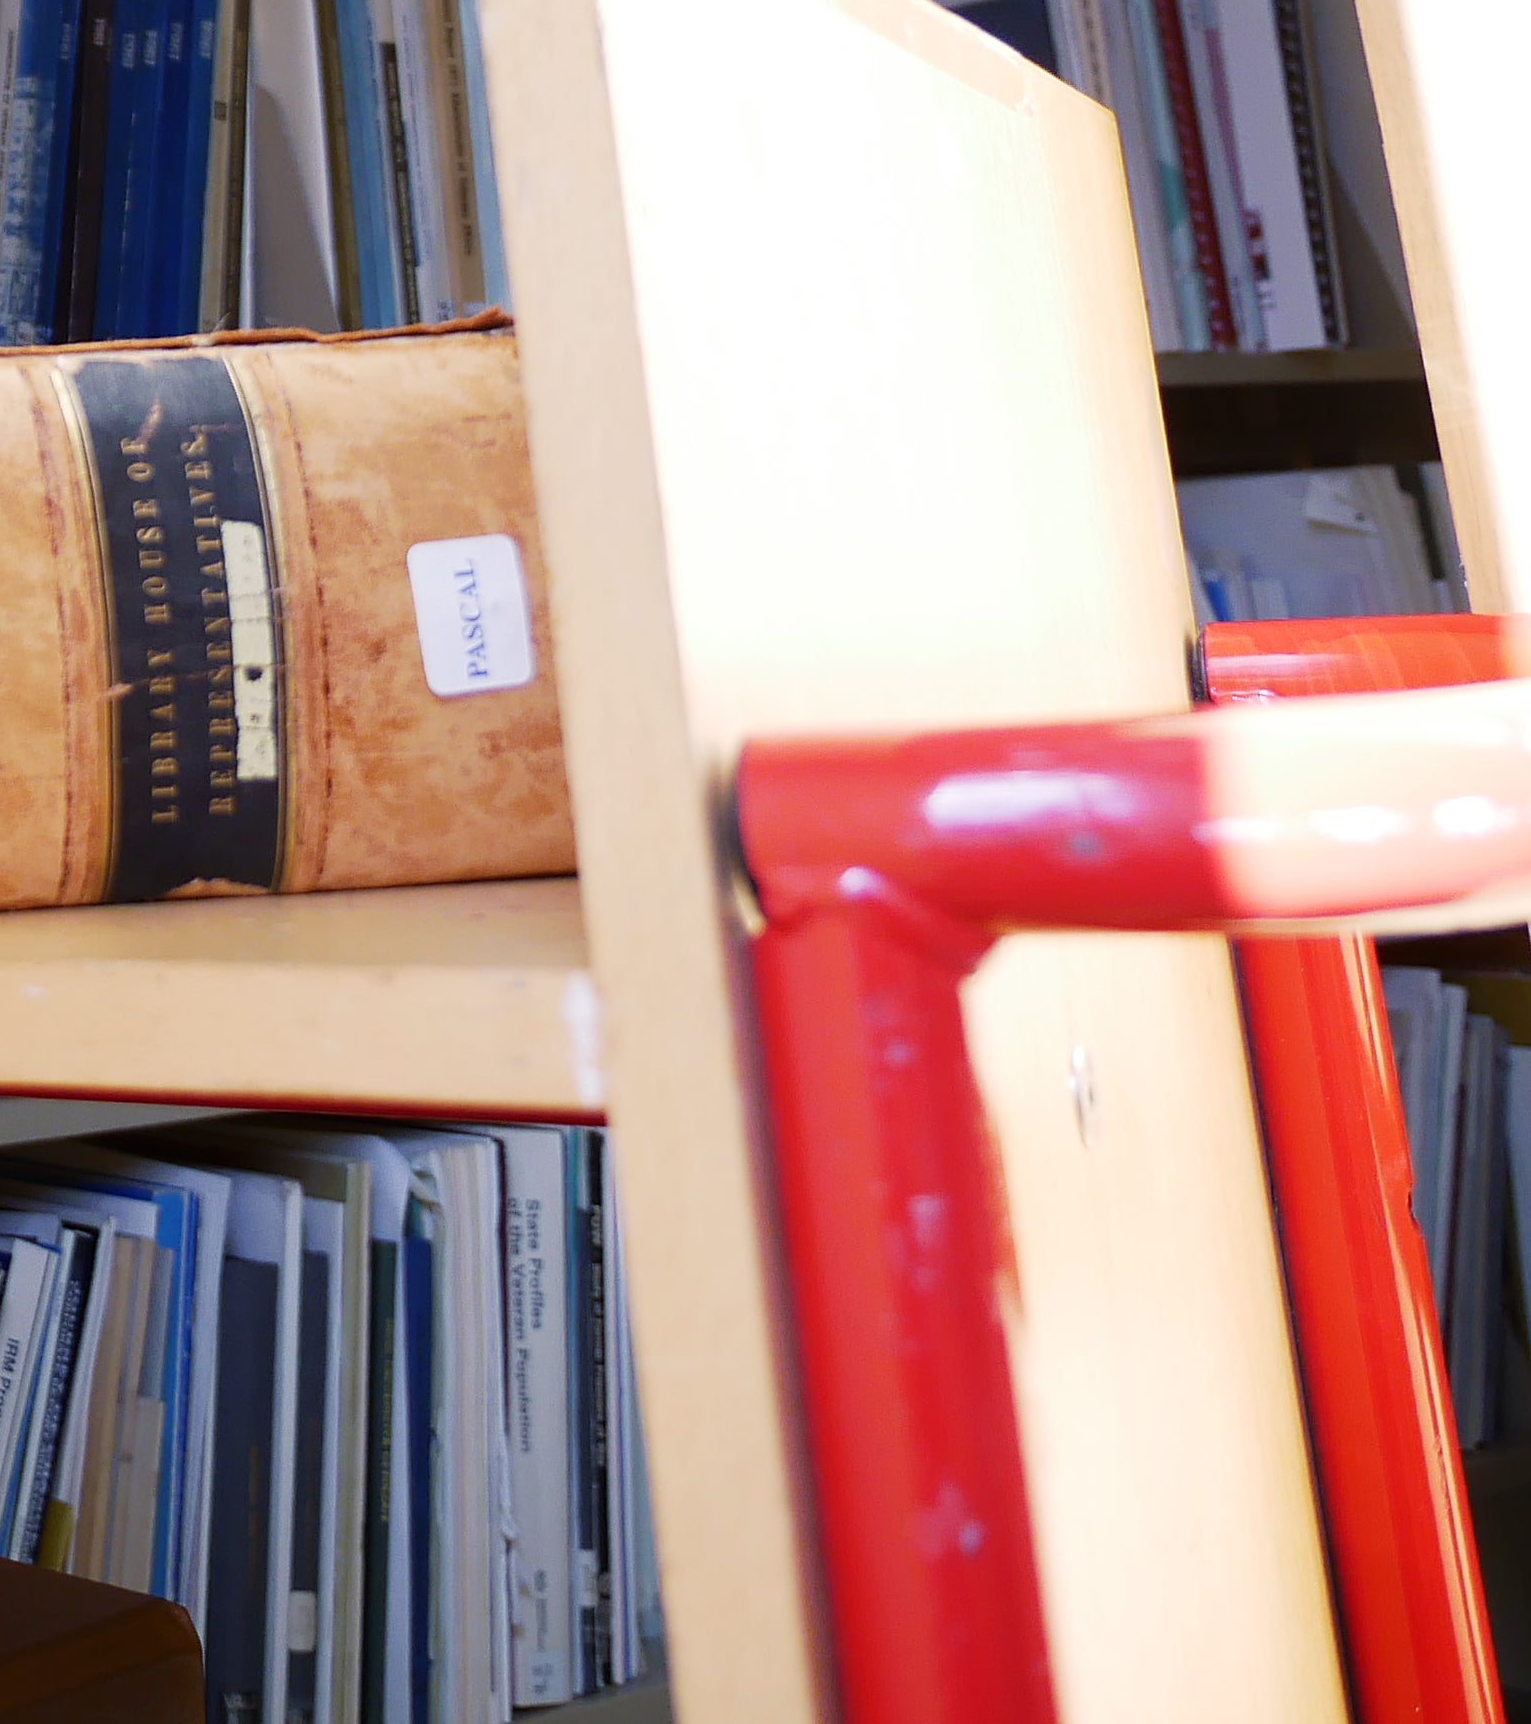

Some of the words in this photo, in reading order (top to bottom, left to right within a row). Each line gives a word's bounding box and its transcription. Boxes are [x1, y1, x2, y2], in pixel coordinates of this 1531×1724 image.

[119, 436, 158, 483] OF
[131, 497, 172, 625] HOUSE
[453, 559, 490, 679] PASCAL
[146, 648, 181, 825] LIBRARY
[507, 1198, 522, 1218] of
[509, 1224, 524, 1256] the
[526, 1198, 540, 1252] State
[512, 1263, 526, 1341] Veteran
[531, 1257, 545, 1329] Profiles
[2, 1337, 20, 1374] IRM
[517, 1347, 532, 1453] Population
